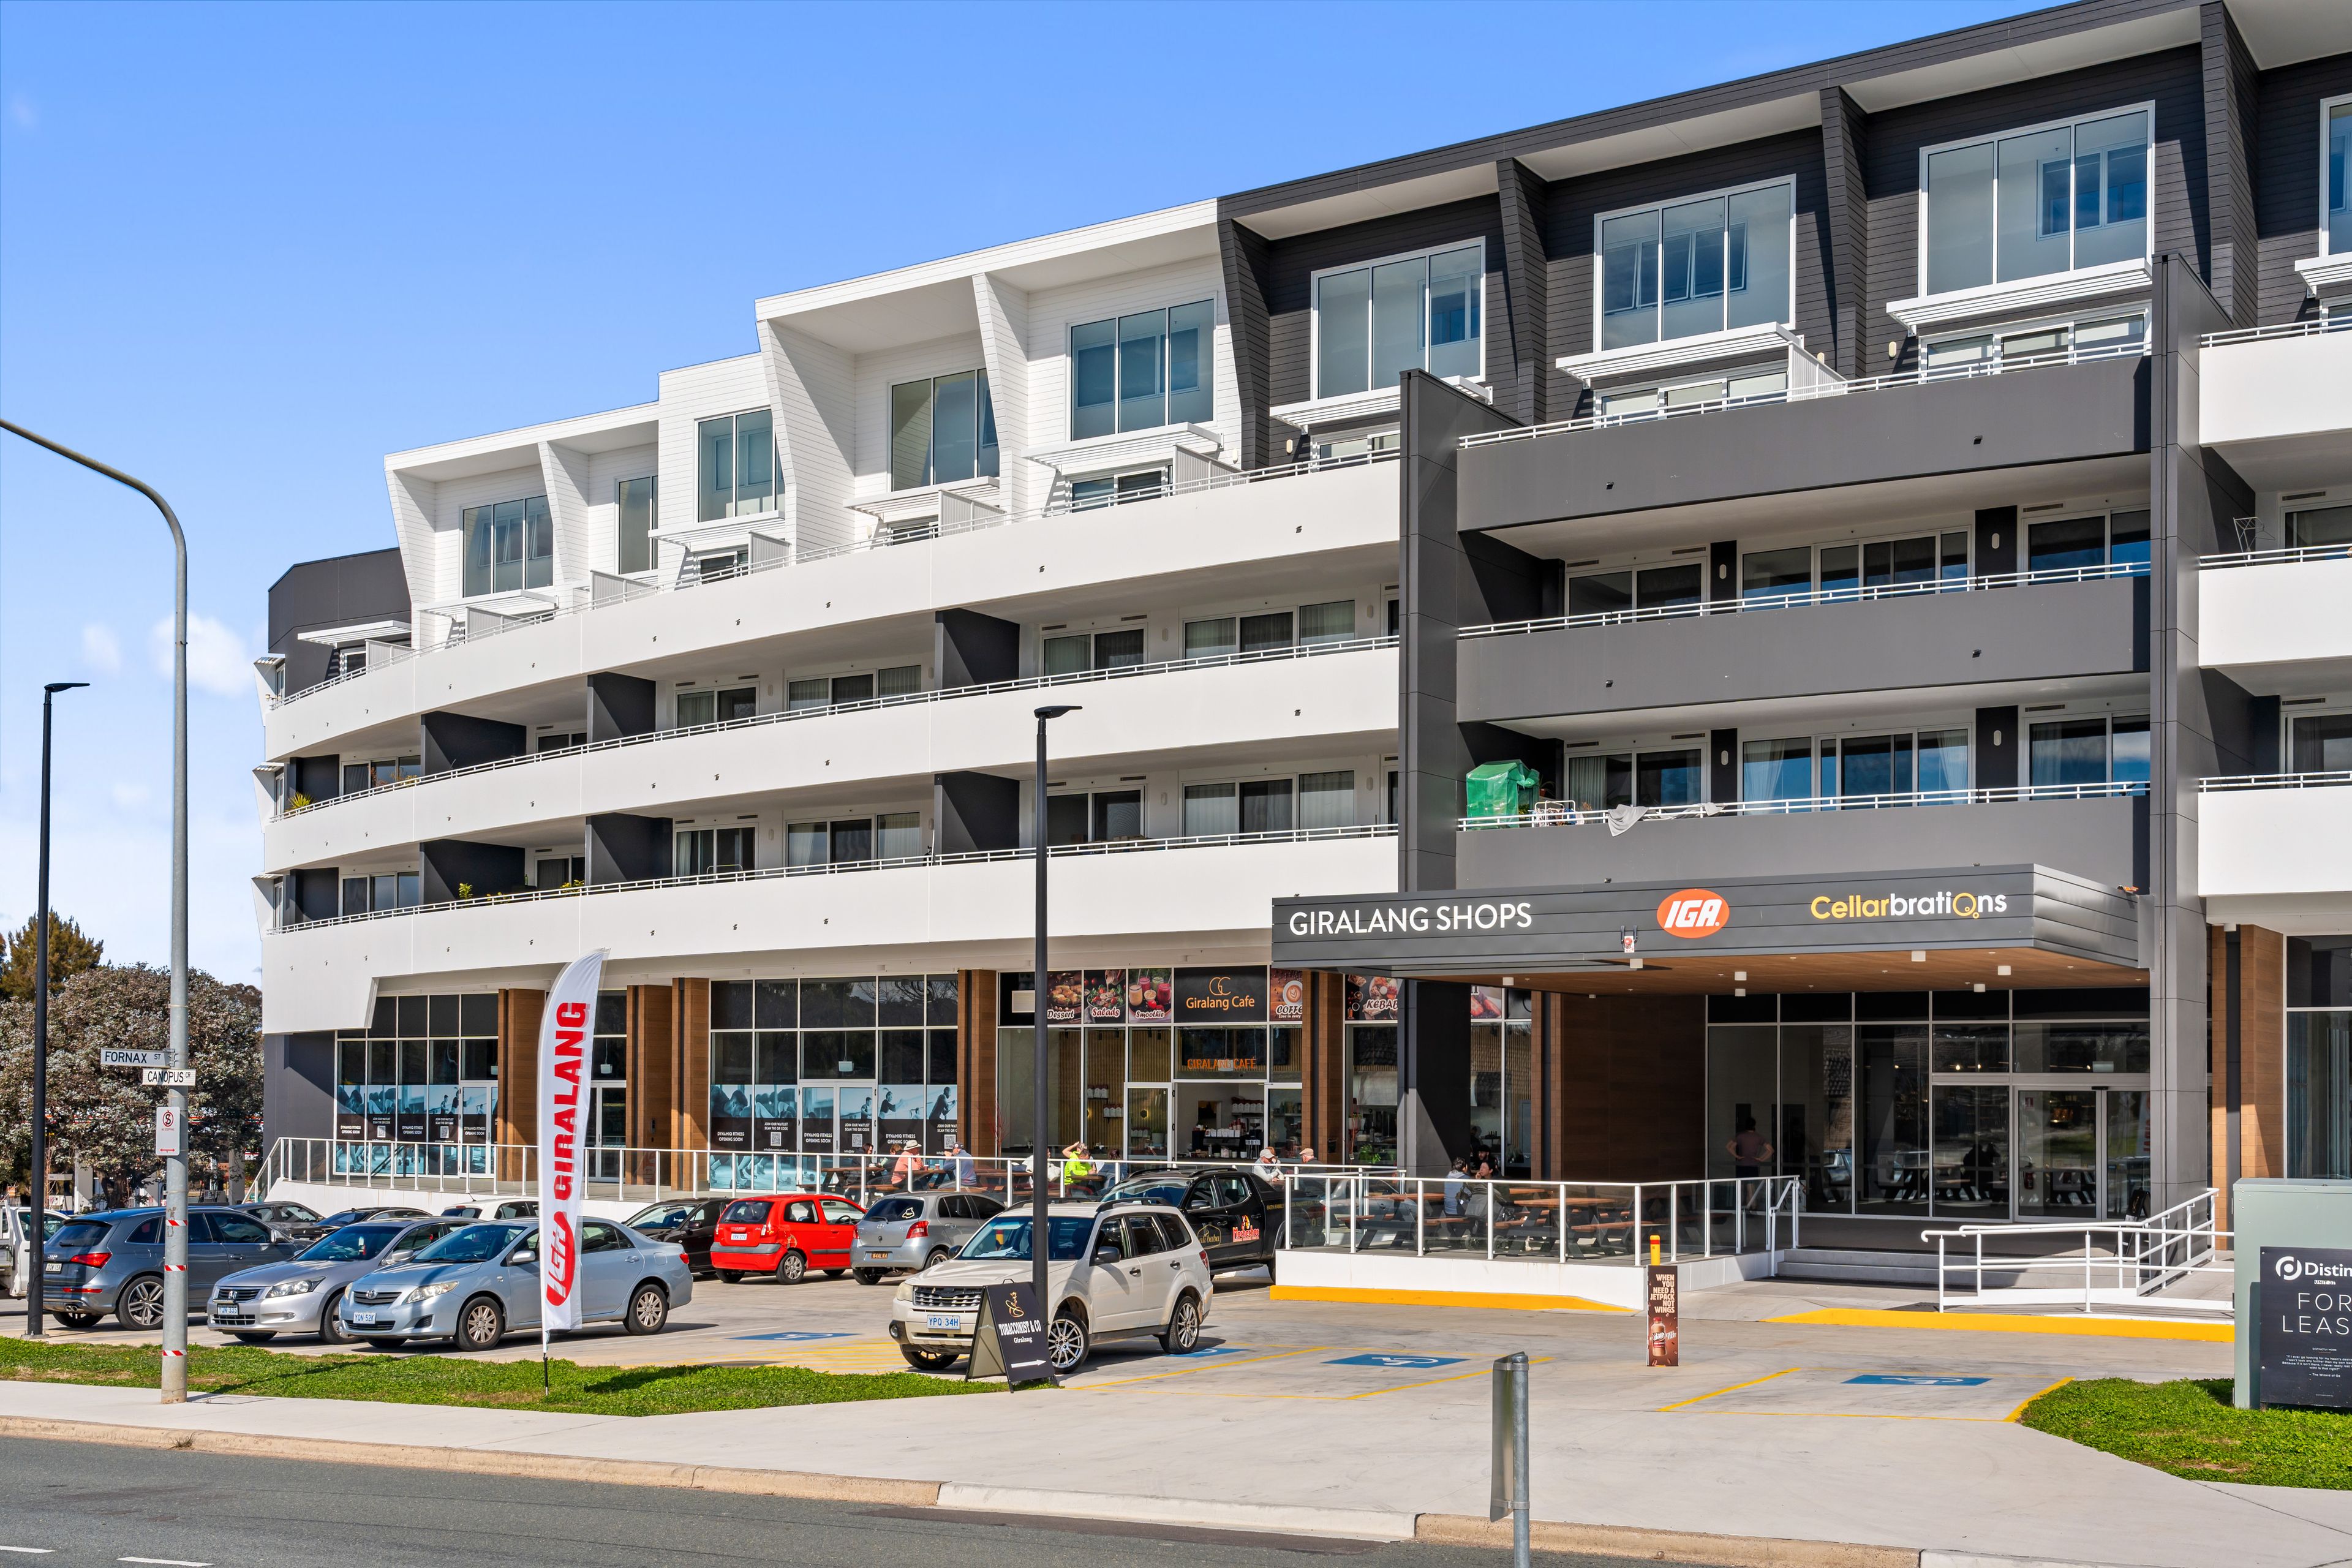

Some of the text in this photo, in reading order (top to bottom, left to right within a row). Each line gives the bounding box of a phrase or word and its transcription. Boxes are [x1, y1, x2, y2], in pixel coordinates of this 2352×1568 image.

[1811, 891, 2007, 919] Cellarbrations
[1289, 902, 1532, 937] GIRALANG SHOPS
[1664, 899, 1720, 929] IGA
[1186, 995, 1255, 1011] Giralang Cafe
[1048, 1009, 1074, 1019] Dessert
[1092, 1007, 1120, 1017] Salads
[1136, 1010, 1164, 1019] Smoothie
[105, 1051, 147, 1063] FORNAX
[1187, 1058, 1231, 1069] GIRALANG
[148, 1071, 184, 1083] CANOPUS
[554, 1002, 588, 1200] GIRALANG
[2298, 1292, 2351, 1311] FOR
[998, 1319, 1041, 1336] TOBACCONIST & CO
